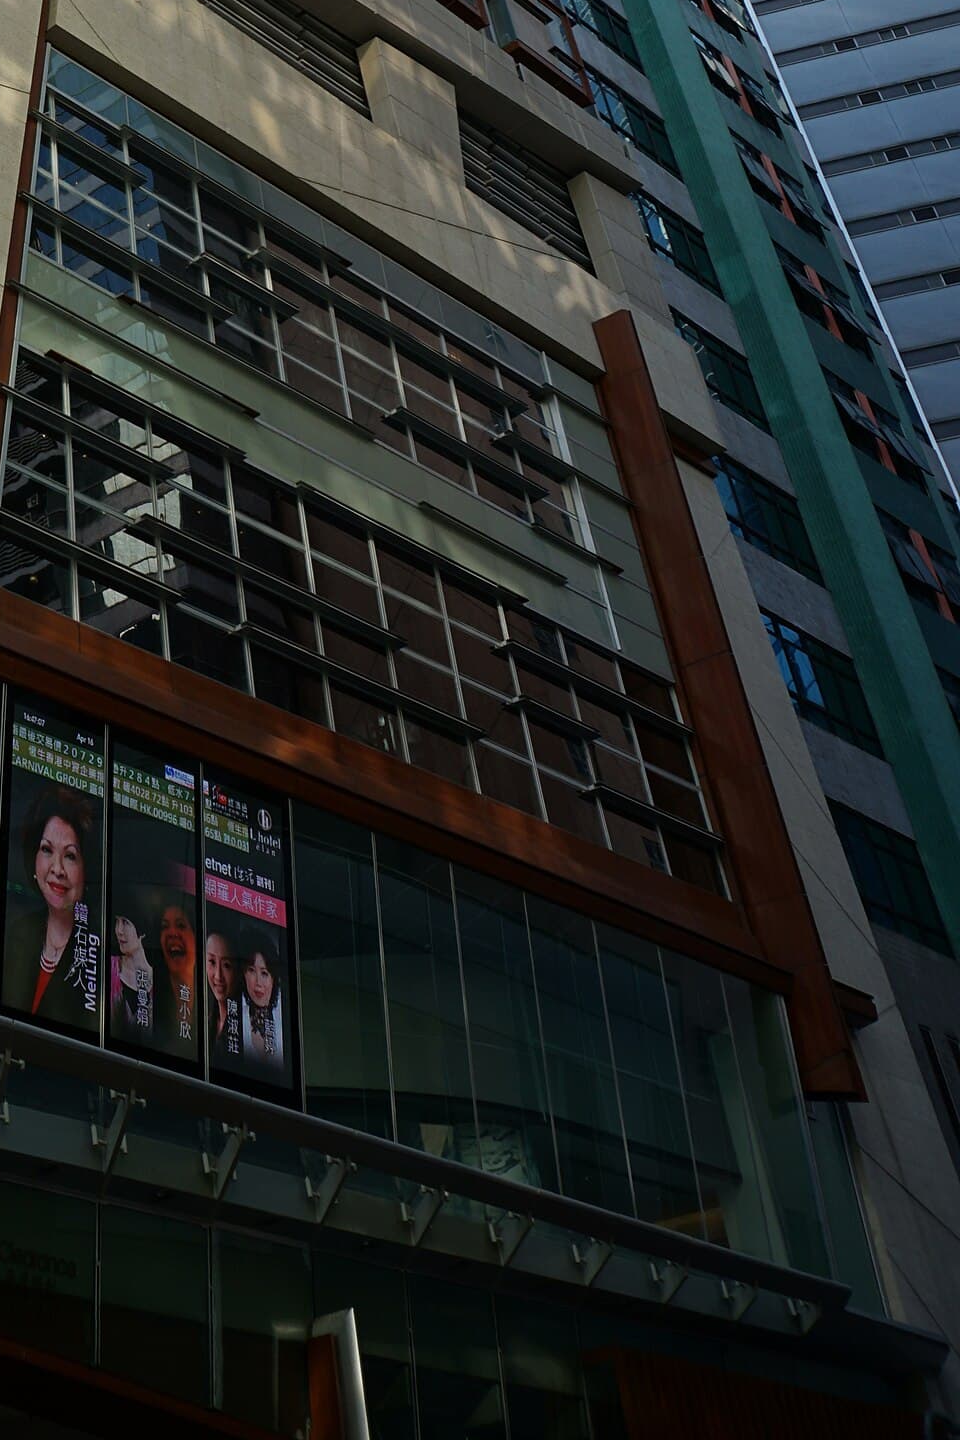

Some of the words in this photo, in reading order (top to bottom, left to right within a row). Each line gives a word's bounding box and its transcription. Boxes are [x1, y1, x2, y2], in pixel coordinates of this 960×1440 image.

[56, 772, 87, 790] GROUP
[205, 857, 232, 877] etnet
[85, 933, 100, 1012] MeiLing
[179, 984, 192, 1040] 查小欣
